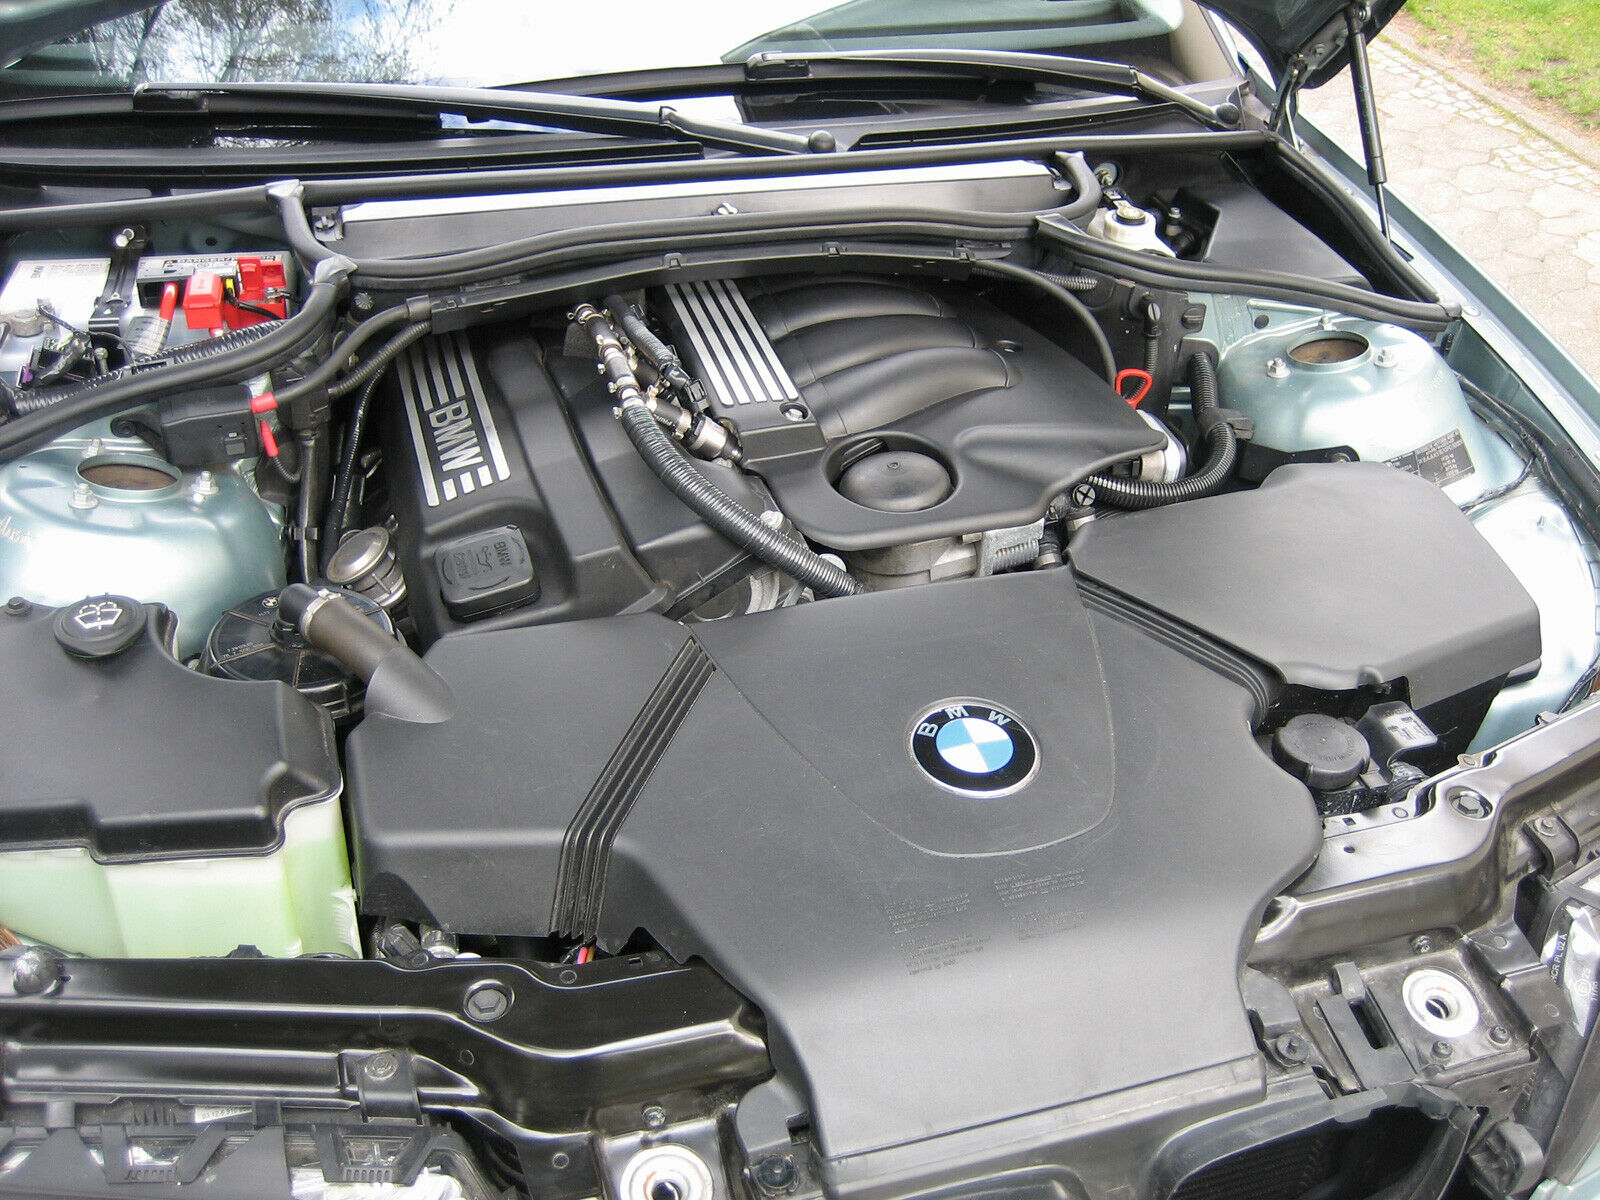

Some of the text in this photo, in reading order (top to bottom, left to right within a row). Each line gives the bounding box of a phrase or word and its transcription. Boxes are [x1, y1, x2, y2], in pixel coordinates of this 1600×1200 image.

[429, 399, 484, 472] BMW
[493, 541, 513, 567] BMW
[916, 705, 1012, 738] BMW
